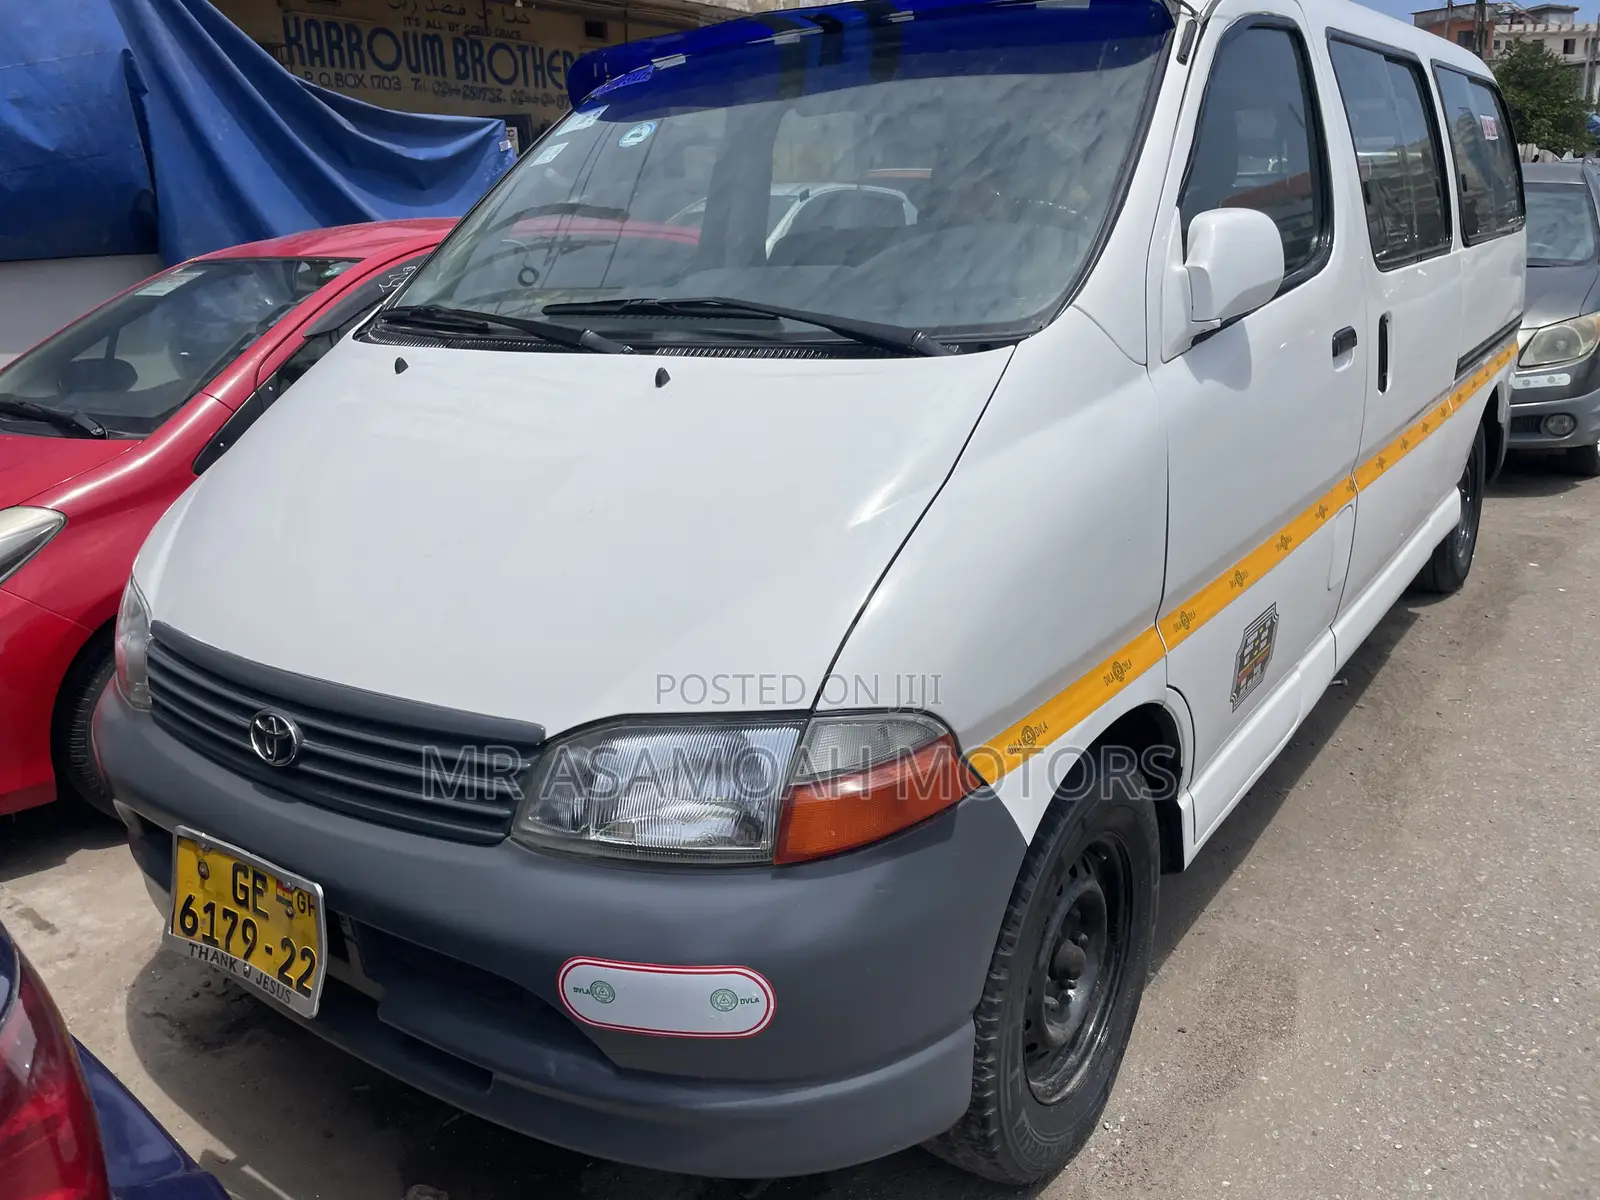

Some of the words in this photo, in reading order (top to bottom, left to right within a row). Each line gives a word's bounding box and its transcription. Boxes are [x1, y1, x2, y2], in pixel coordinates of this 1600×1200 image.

[426, 18, 444, 30] ALL
[283, 16, 447, 76] KARROUM
[453, 36, 576, 91] BROTHER
[1007, 738, 1022, 756] DVLA
[1034, 720, 1049, 739] DVLA
[232, 861, 269, 920] GE
[179, 893, 317, 998] 6179-22
[189, 942, 237, 973] THANK
[255, 972, 292, 1004] JESUS
[573, 986, 591, 996] DVLA
[739, 996, 760, 1005] DVLA
